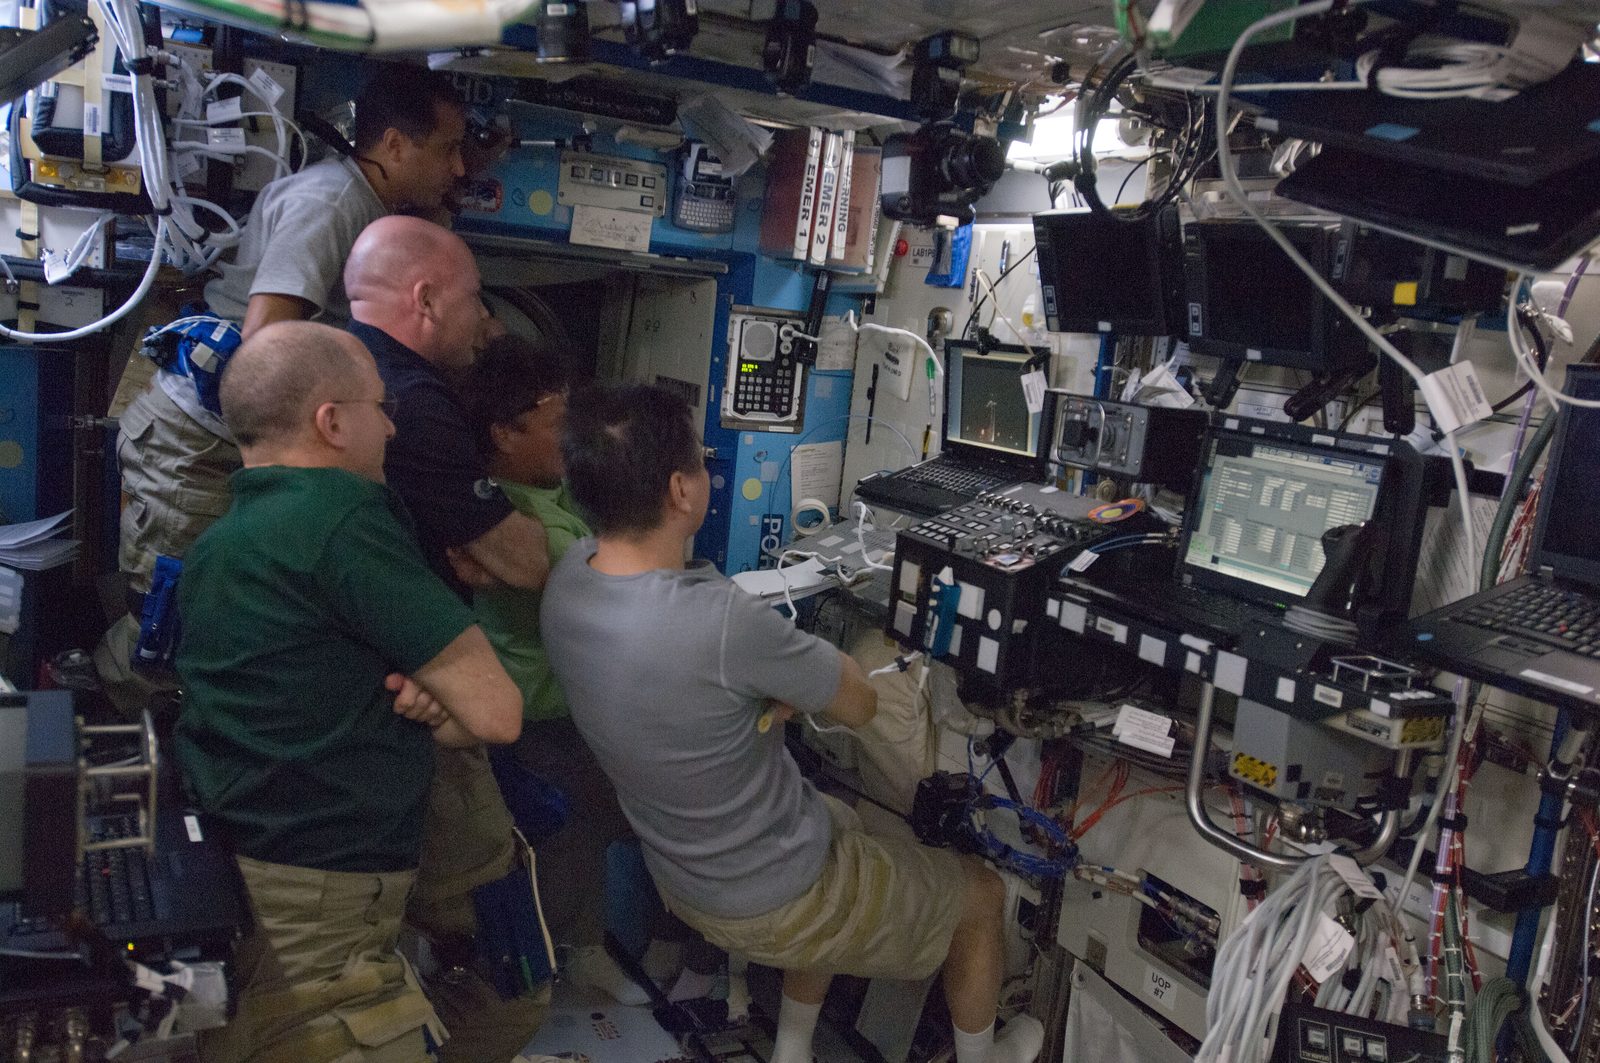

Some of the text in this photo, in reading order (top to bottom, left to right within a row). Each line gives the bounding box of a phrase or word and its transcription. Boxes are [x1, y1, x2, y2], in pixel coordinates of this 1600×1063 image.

[798, 163, 816, 238] EMER 1
[816, 171, 834, 245] EMER 2
[759, 518, 782, 570] POR
[1151, 972, 1171, 990] UOP
[1153, 987, 1164, 999] #7
